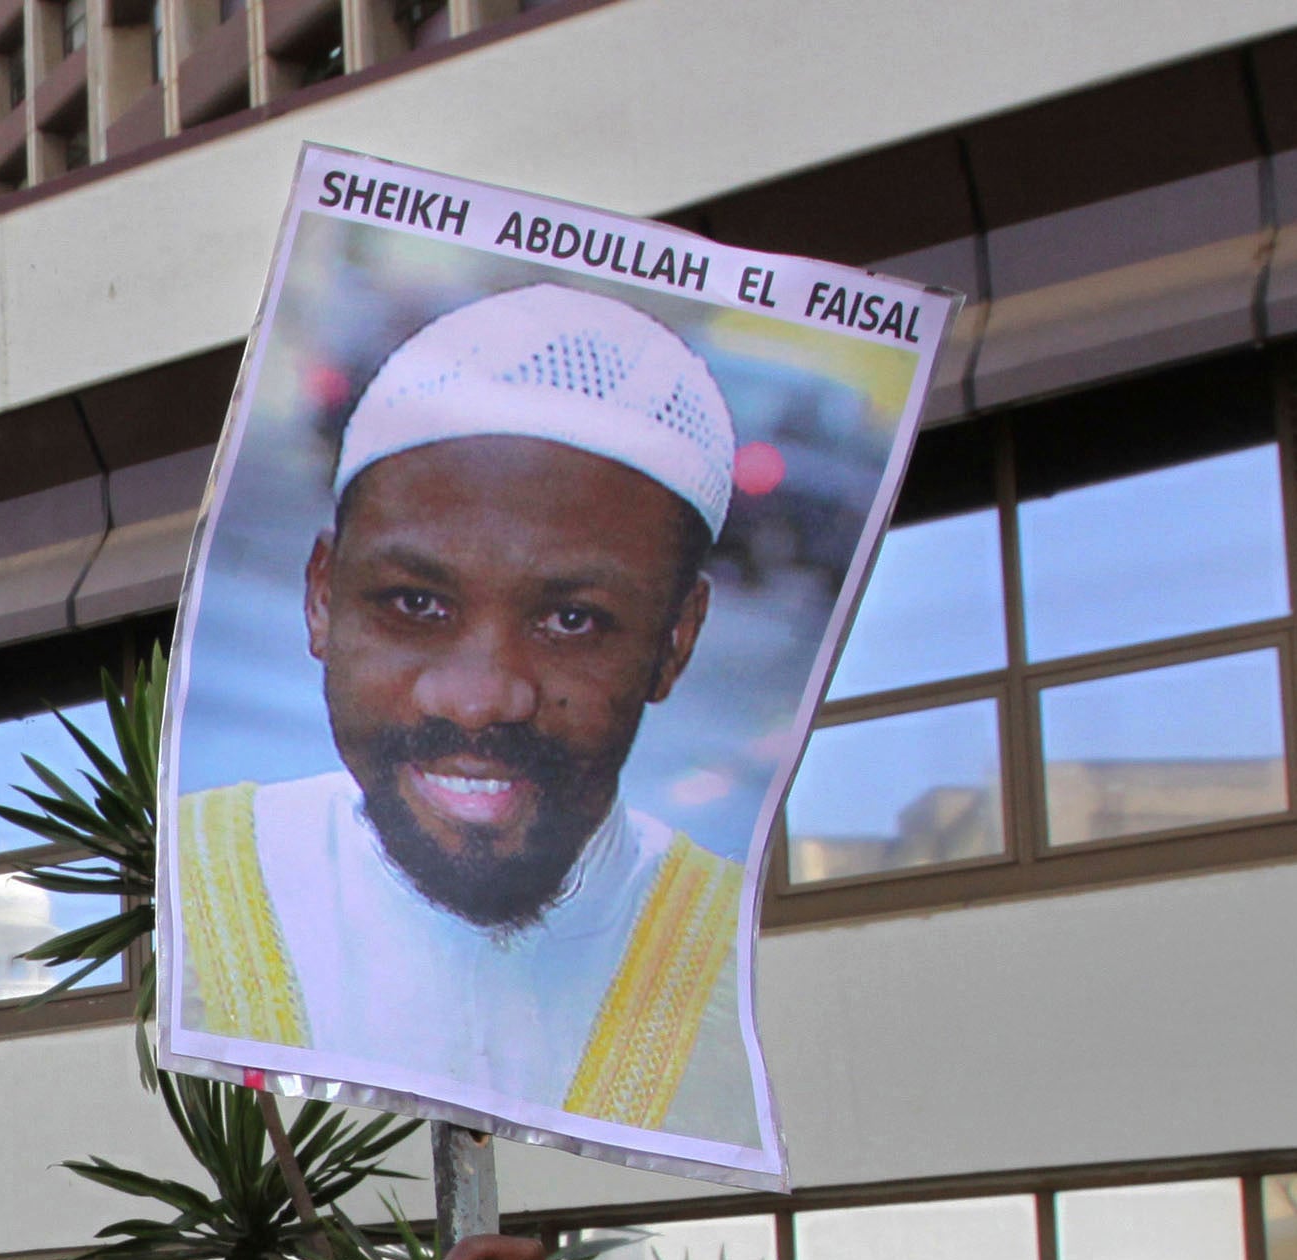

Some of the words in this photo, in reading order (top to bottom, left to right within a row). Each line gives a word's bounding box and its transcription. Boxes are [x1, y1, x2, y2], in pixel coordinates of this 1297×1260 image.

[318, 170, 470, 236] SHEIKH
[495, 211, 709, 291] ABDULLAH
[737, 266, 775, 308] EL
[805, 282, 920, 344] FAISAL
